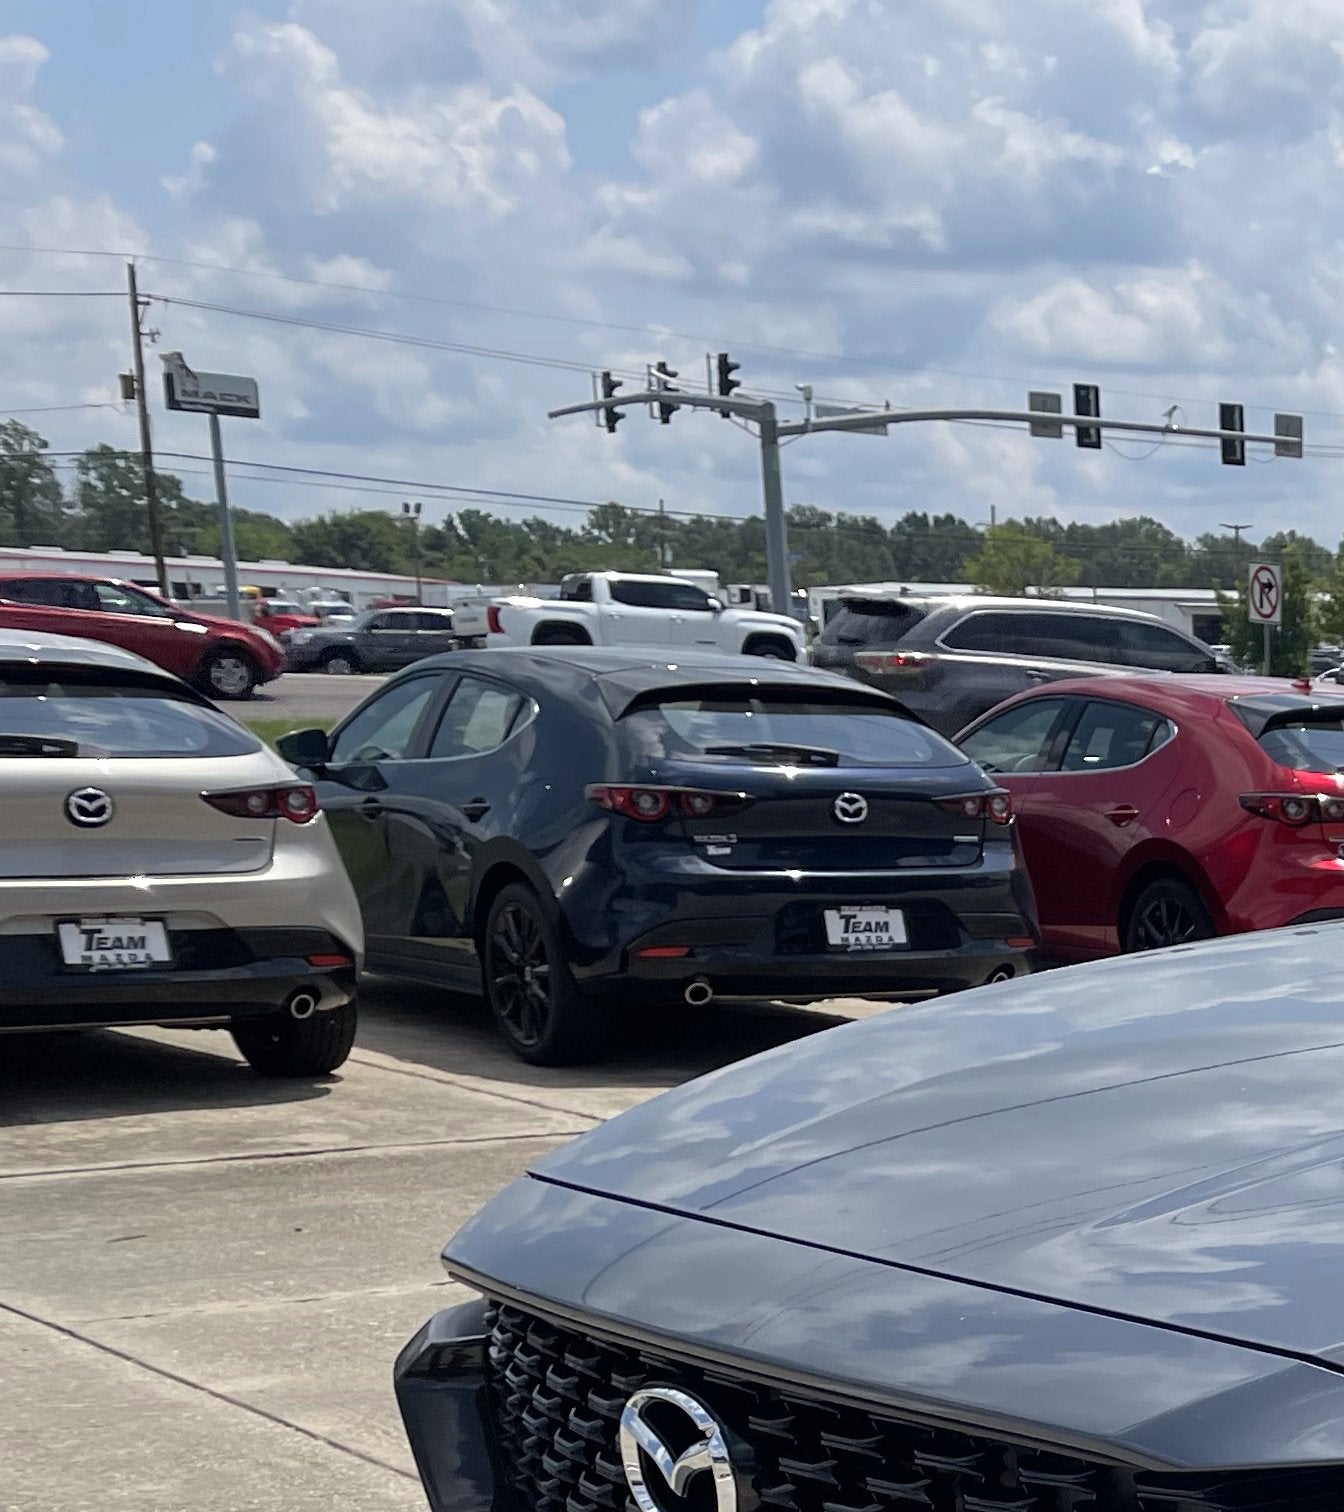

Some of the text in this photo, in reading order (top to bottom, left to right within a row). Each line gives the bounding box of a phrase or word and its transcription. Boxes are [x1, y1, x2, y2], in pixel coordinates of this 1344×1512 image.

[181, 388, 251, 404] MACK
[839, 914, 889, 934] TEAM
[80, 928, 147, 952] TEAM
